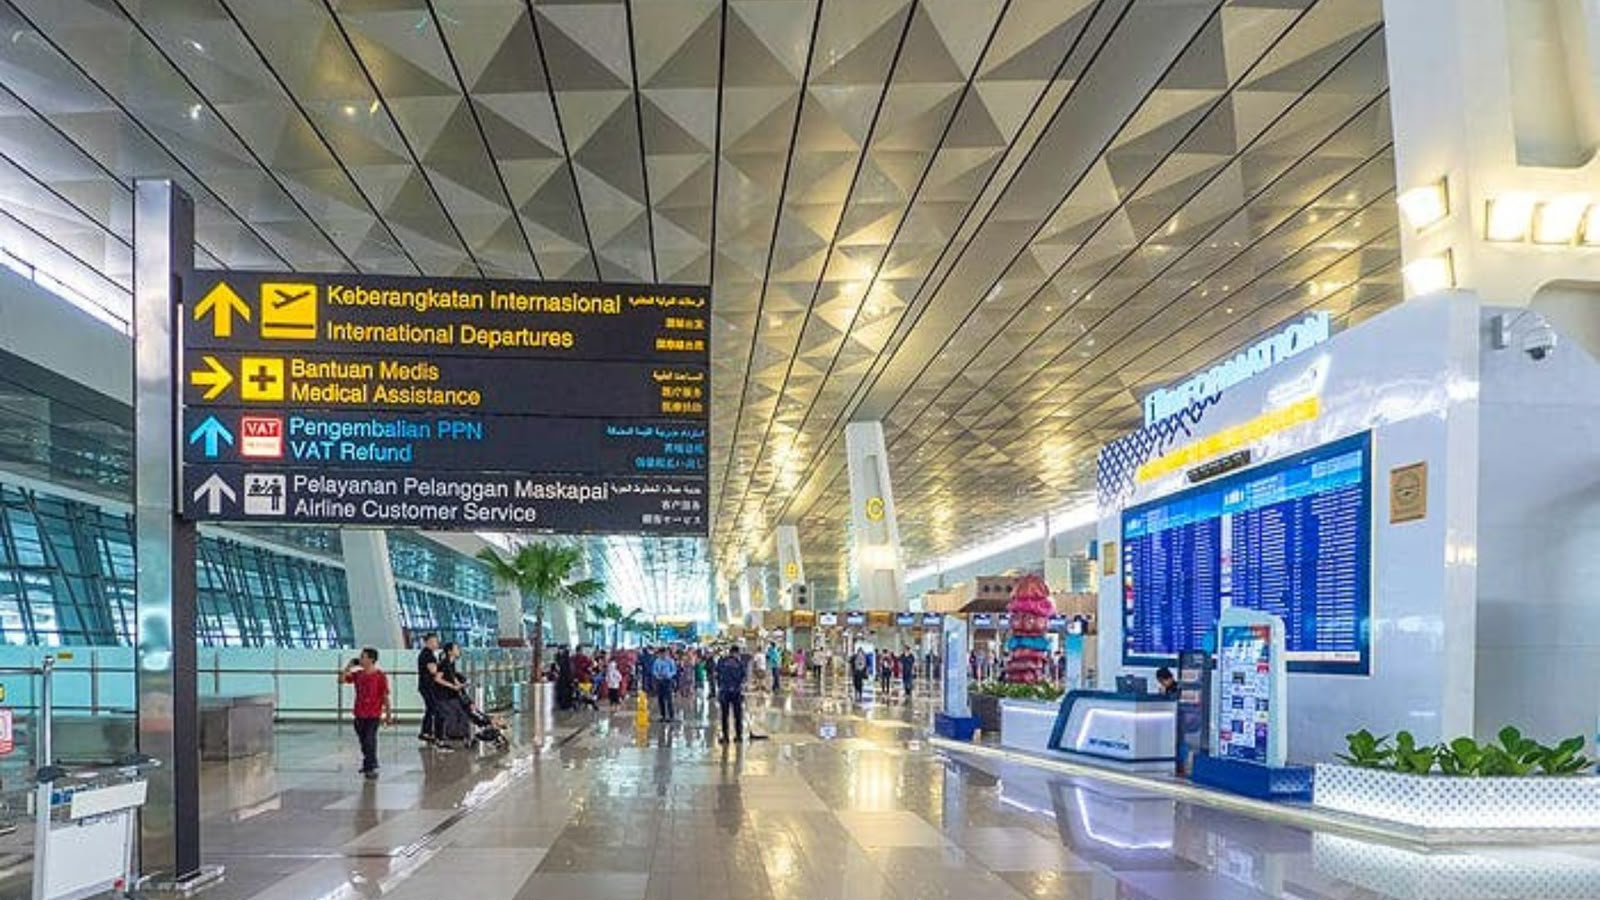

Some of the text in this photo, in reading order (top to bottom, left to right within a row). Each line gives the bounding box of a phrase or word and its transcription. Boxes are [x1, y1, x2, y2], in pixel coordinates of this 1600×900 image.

[328, 285, 484, 312] Keberangkatan
[490, 291, 621, 314] Internasional
[327, 322, 574, 348] International Departures
[291, 358, 439, 380] Bantuan Medis
[291, 383, 480, 405] Medical Assistance
[246, 422, 278, 436] VAT
[290, 417, 483, 440] Pengembalian PPN
[290, 441, 336, 460] VAT
[341, 442, 412, 461] Refund
[294, 474, 397, 497] Pelayanan
[404, 477, 509, 500] Pelanggan
[515, 480, 609, 503] Maskapai
[294, 500, 536, 522] Airline Customer Service
[866, 496, 885, 521] C
